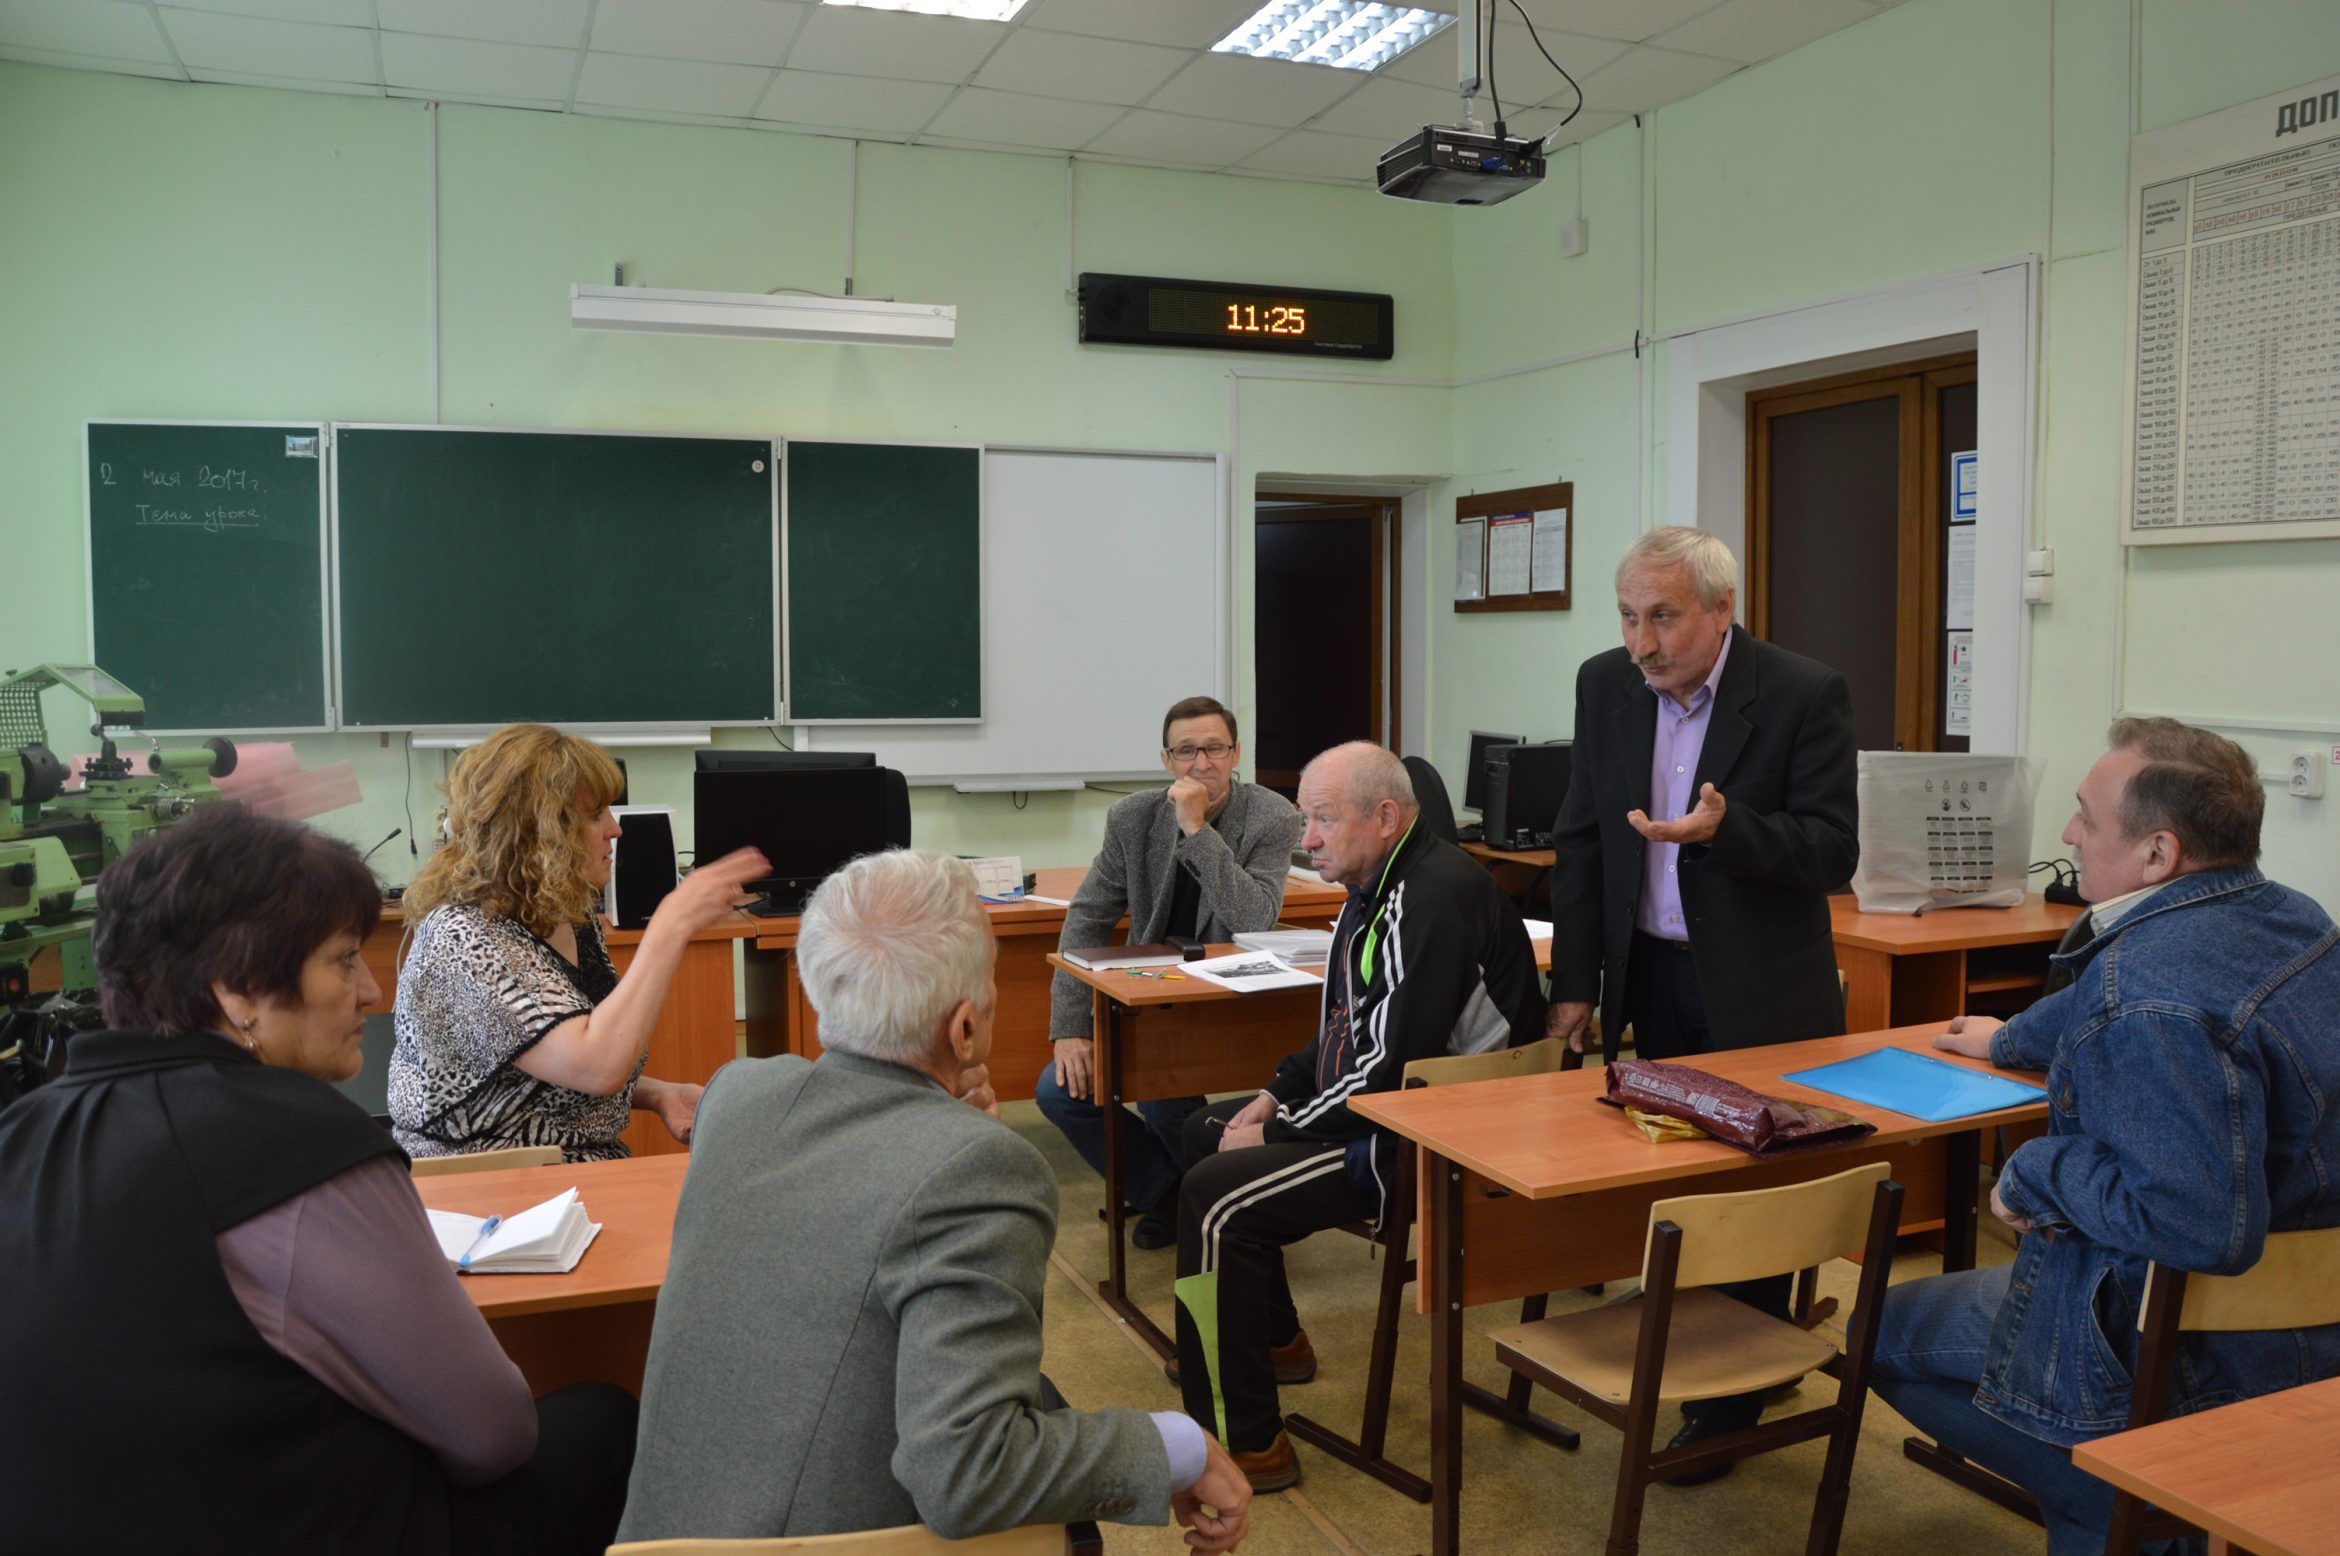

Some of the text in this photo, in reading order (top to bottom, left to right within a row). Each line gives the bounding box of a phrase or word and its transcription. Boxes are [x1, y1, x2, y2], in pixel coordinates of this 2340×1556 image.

[2275, 89, 2339, 138] ДОП
[1227, 303, 1305, 334] 11:25
[100, 462, 117, 485] 2
[142, 467, 181, 488] мая
[136, 504, 192, 523] Тема
